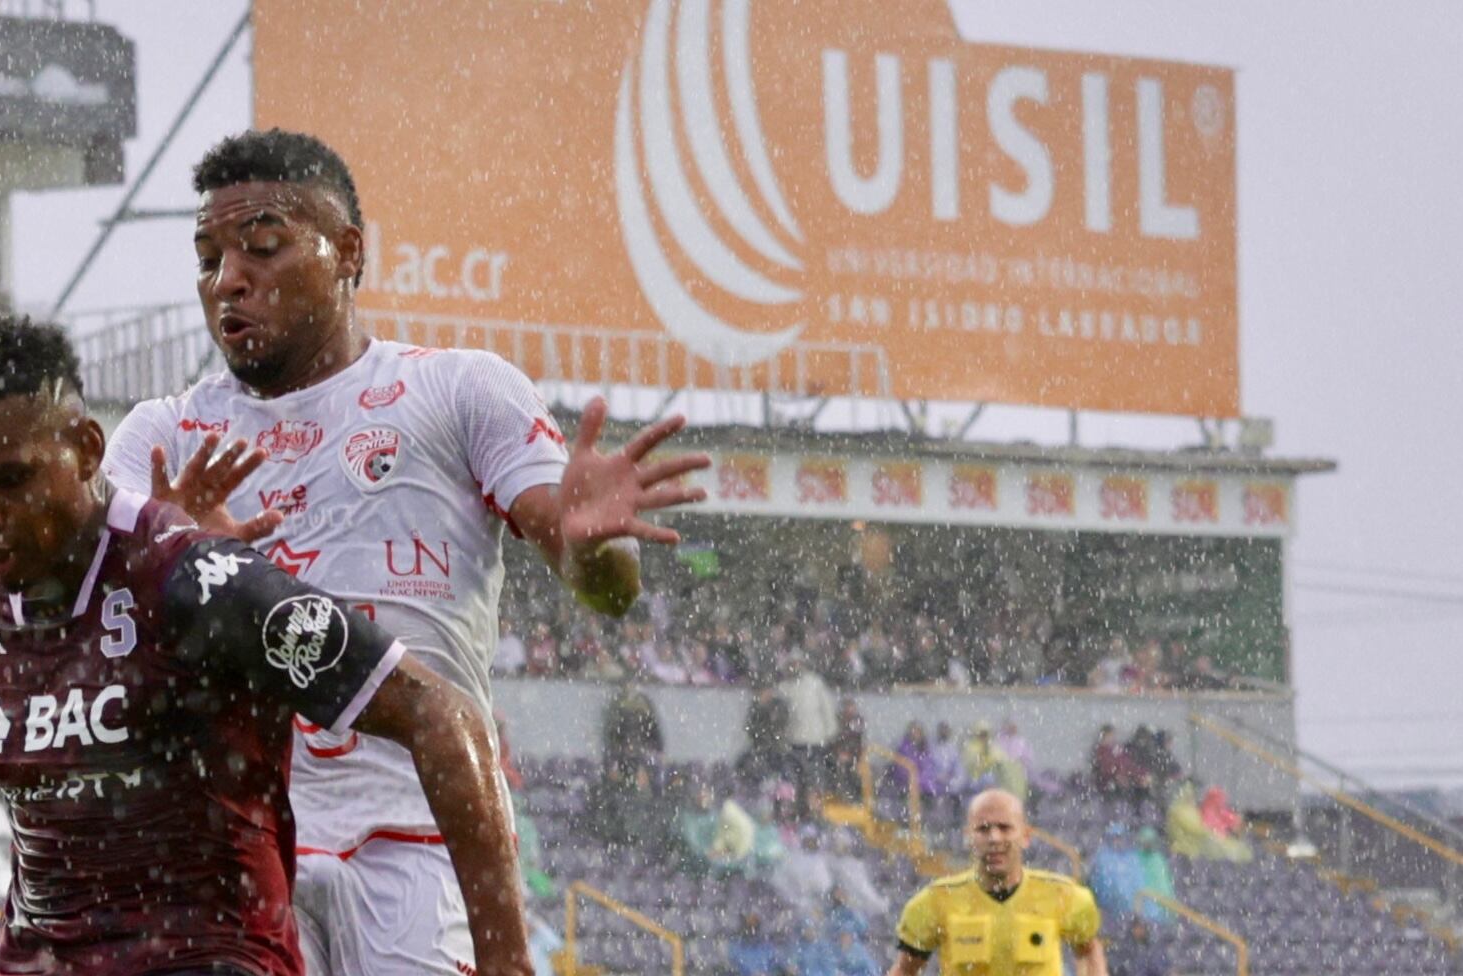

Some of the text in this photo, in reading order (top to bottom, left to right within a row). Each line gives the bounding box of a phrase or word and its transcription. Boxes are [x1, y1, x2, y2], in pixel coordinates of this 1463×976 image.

[823, 49, 1200, 237] UISIL
[363, 219, 508, 300] l.ac.cr
[100, 587, 138, 657] S
[24, 685, 129, 751] BAC
